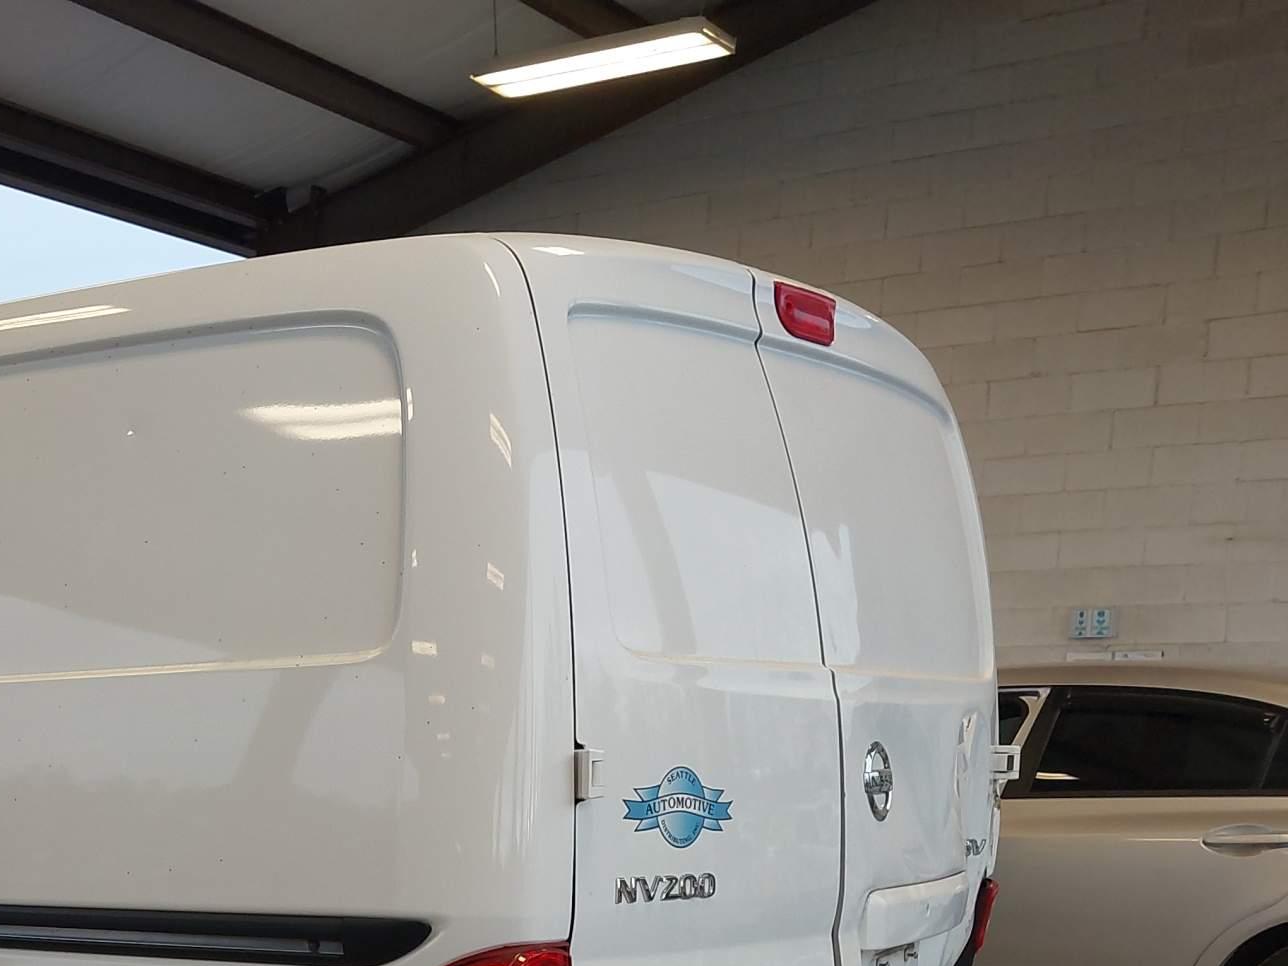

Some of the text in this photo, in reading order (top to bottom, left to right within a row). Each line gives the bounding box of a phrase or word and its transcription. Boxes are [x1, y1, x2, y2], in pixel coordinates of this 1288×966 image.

[666, 770, 696, 786] SEATTLE
[646, 796, 715, 816] AUTOMOTIVE
[615, 872, 716, 905] NV200
